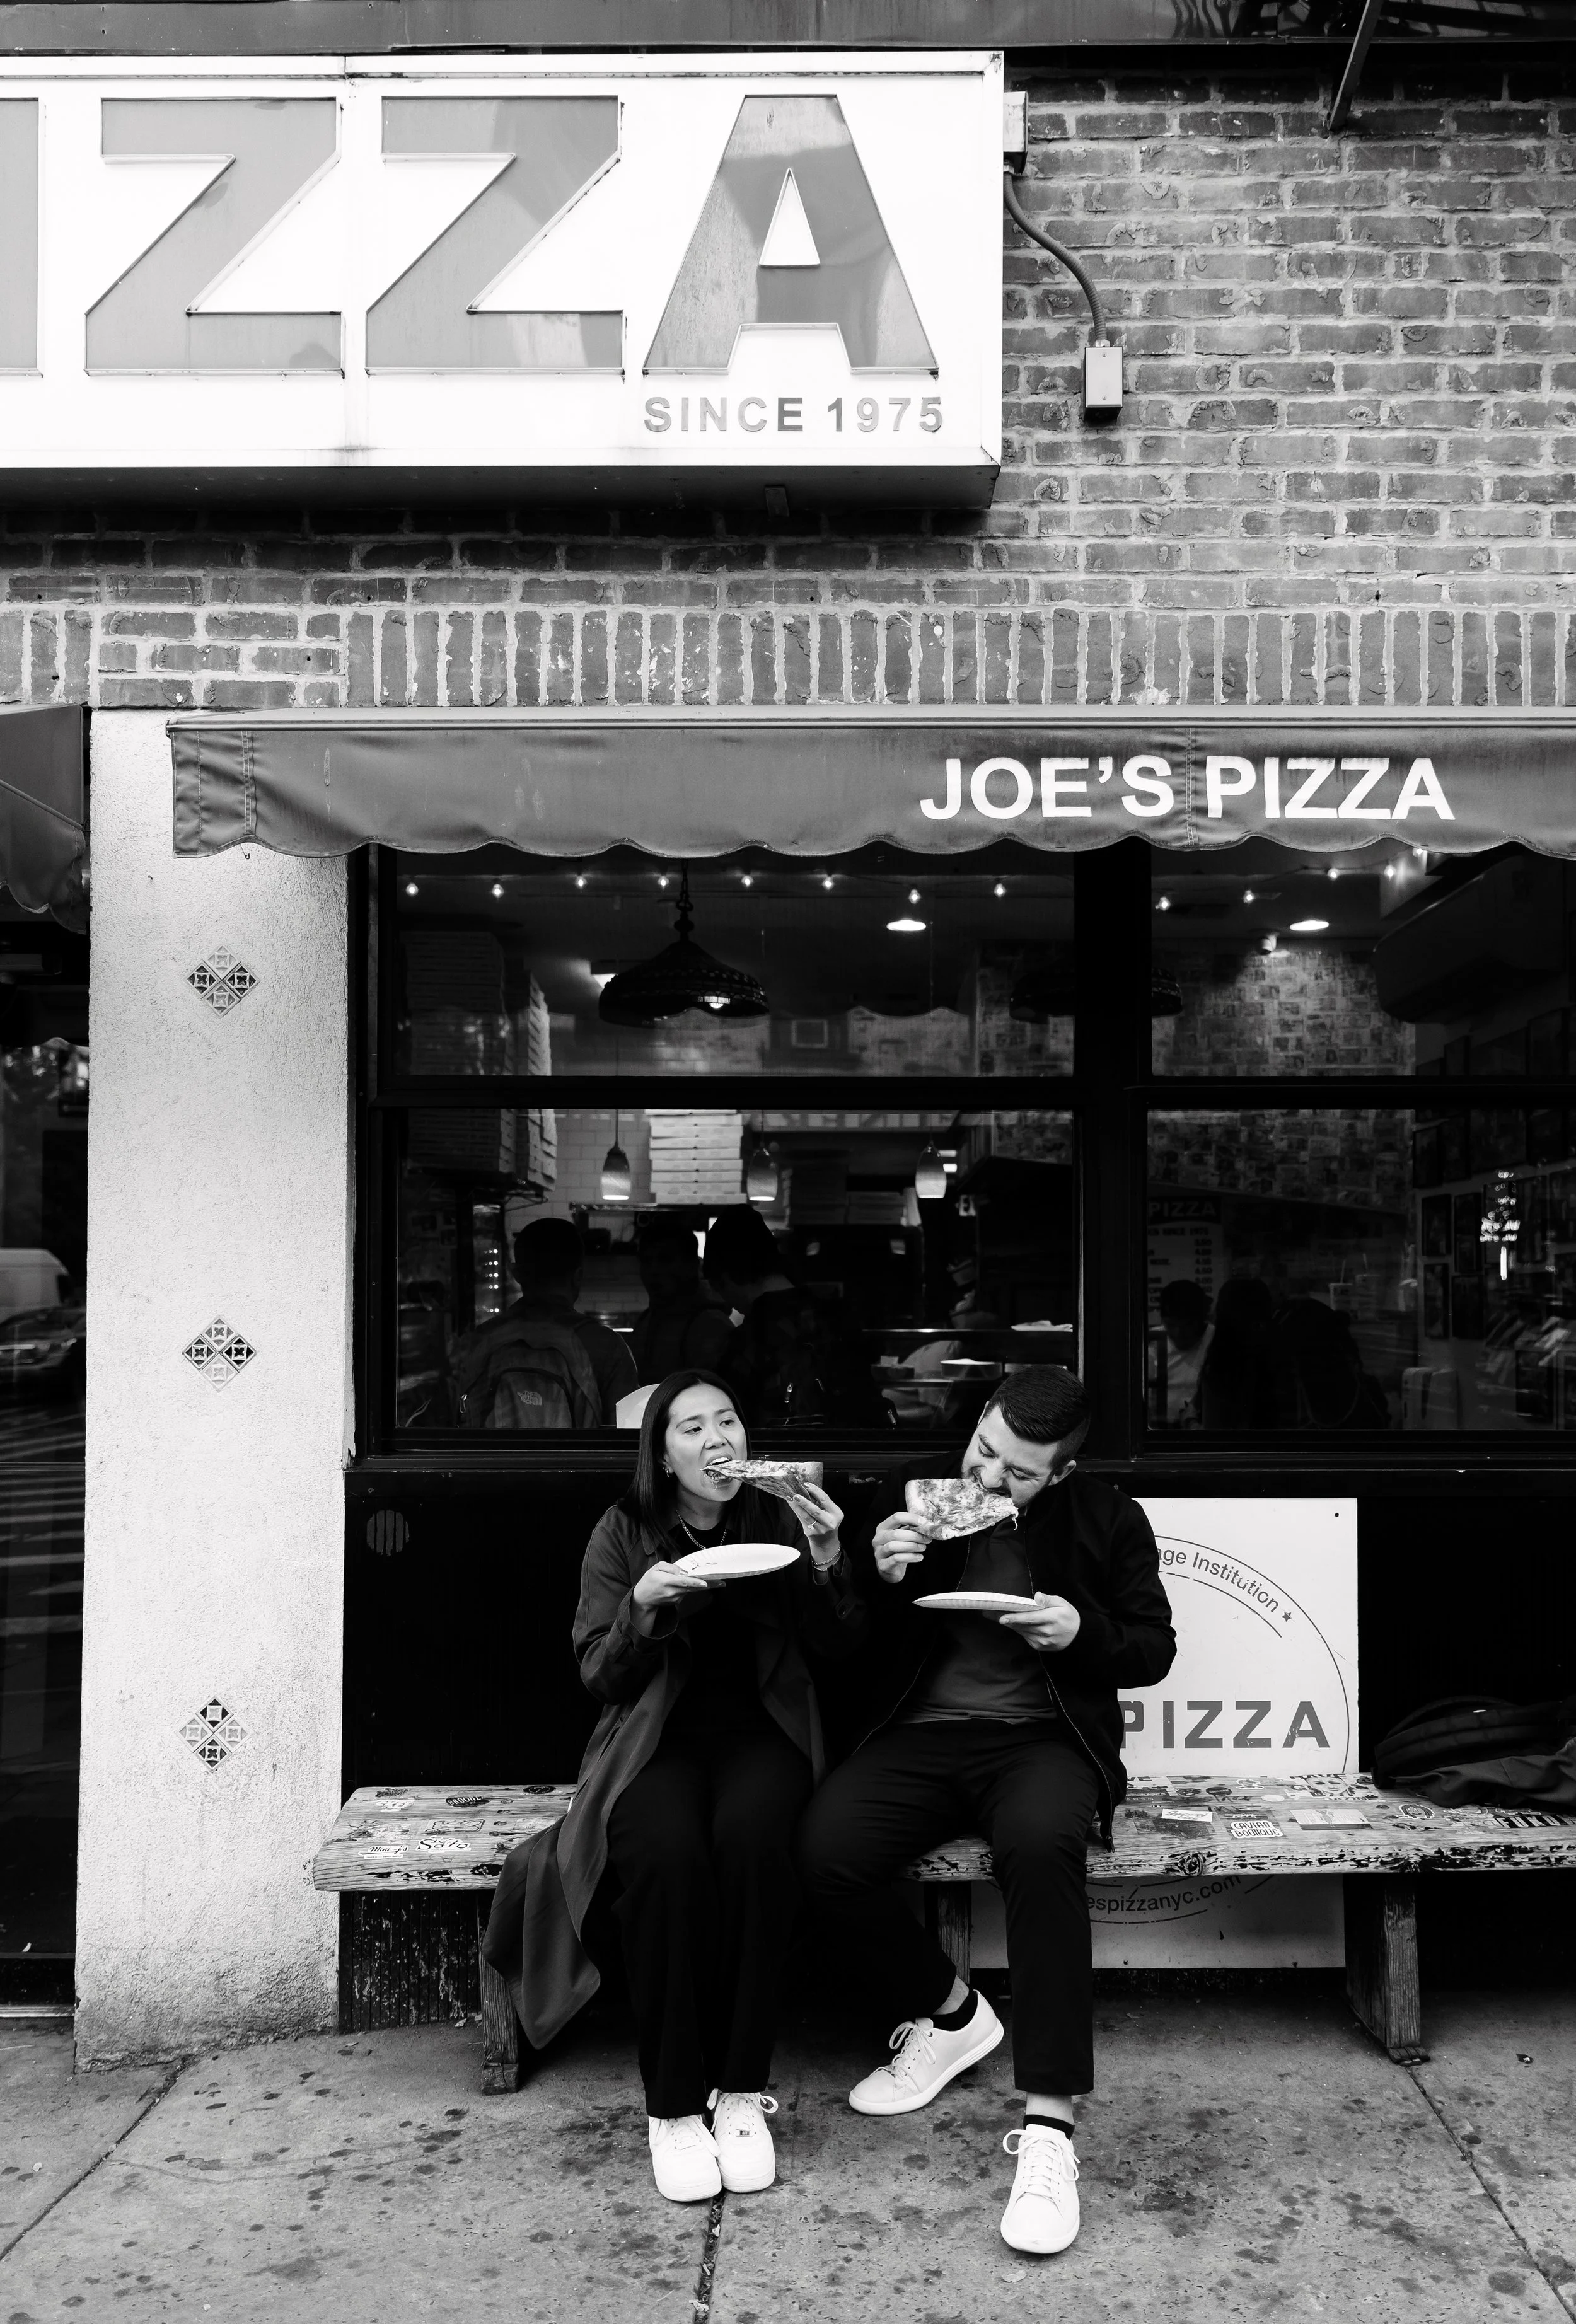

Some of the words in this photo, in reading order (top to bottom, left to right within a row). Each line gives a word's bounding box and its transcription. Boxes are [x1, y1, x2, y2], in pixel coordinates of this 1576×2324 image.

[644, 396, 803, 432] SINCE
[827, 396, 942, 433] 1975
[920, 754, 1175, 821] JOE'S
[1206, 755, 1456, 821] PIZZA
[1148, 1201, 1217, 1218] PIZZA
[1192, 1552, 1279, 1613] Institution
[1118, 1701, 1330, 1749] PIZZA
[1087, 1875, 1241, 1914] espizzanyc.com
